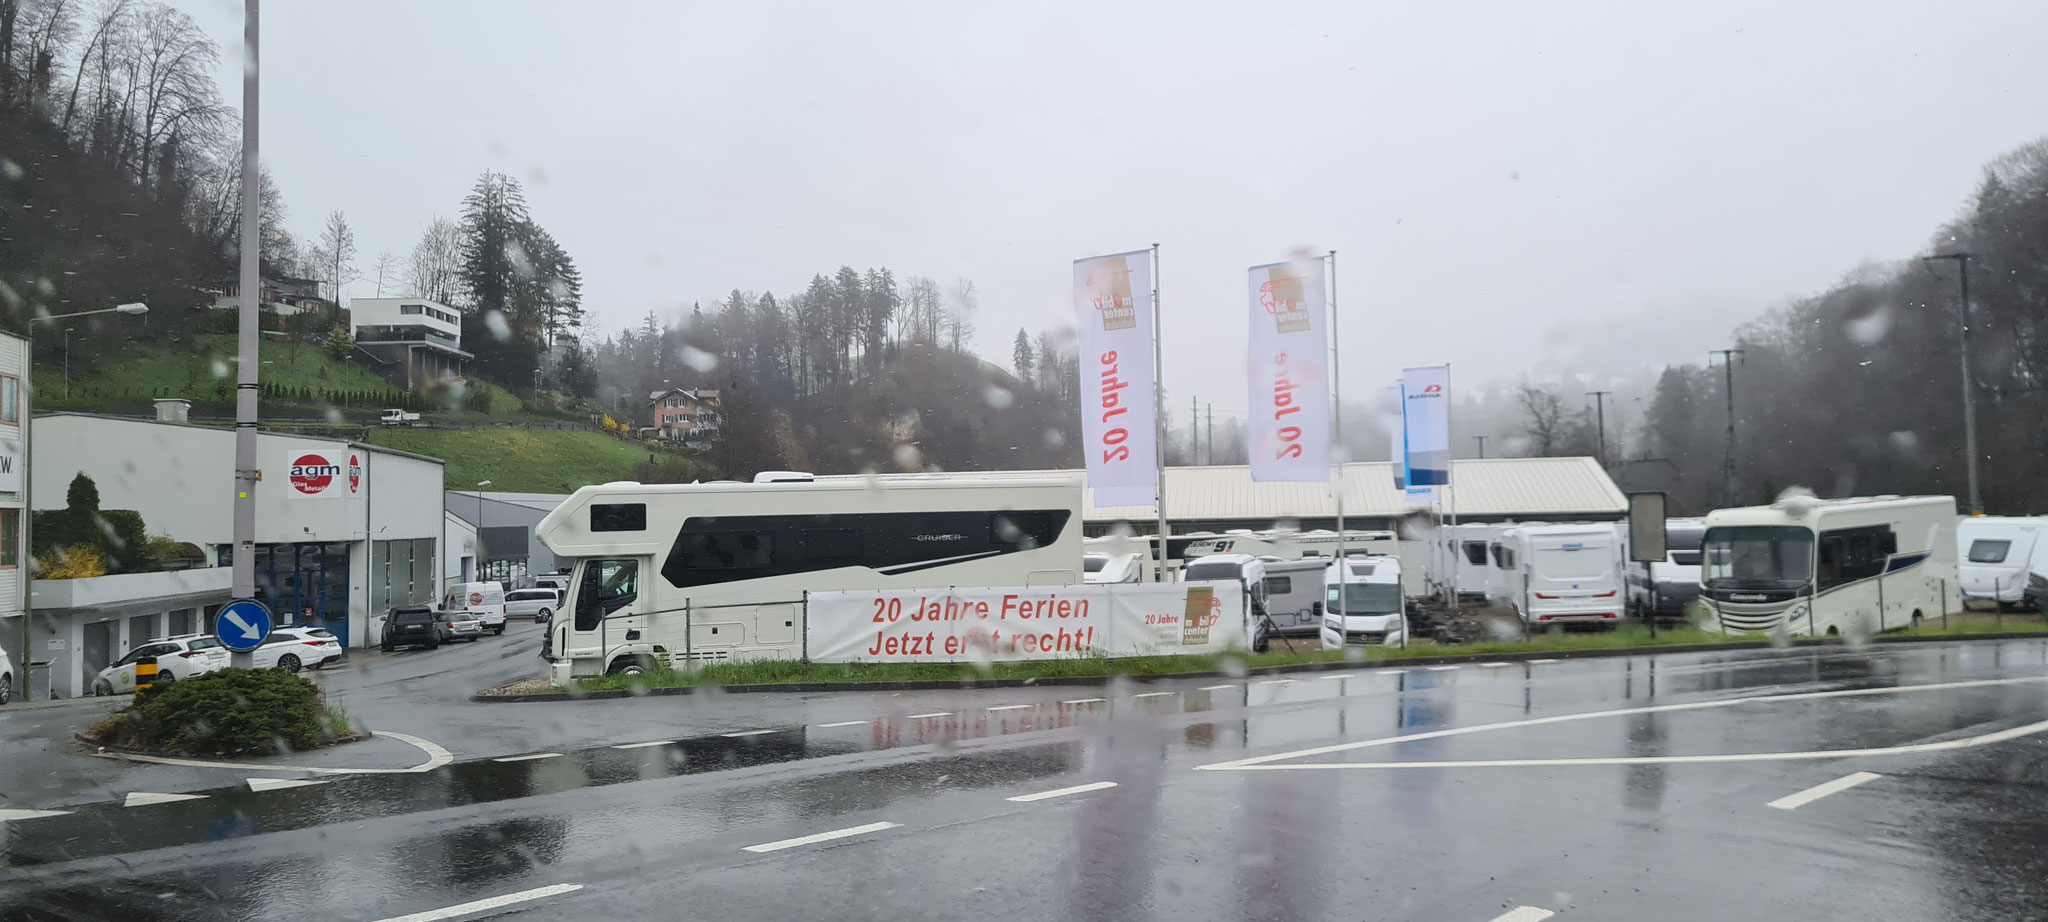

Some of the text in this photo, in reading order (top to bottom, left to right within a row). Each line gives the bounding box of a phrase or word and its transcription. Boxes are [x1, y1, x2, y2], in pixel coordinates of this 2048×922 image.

[291, 465, 340, 480] agm
[1214, 540, 1235, 552] 91
[872, 593, 1090, 623] 20 Jahre Ferien
[1144, 613, 1179, 625] 20 Jahre
[1184, 626, 1209, 636] center
[868, 630, 935, 656] Jetzt
[1010, 626, 1094, 654] recht!
